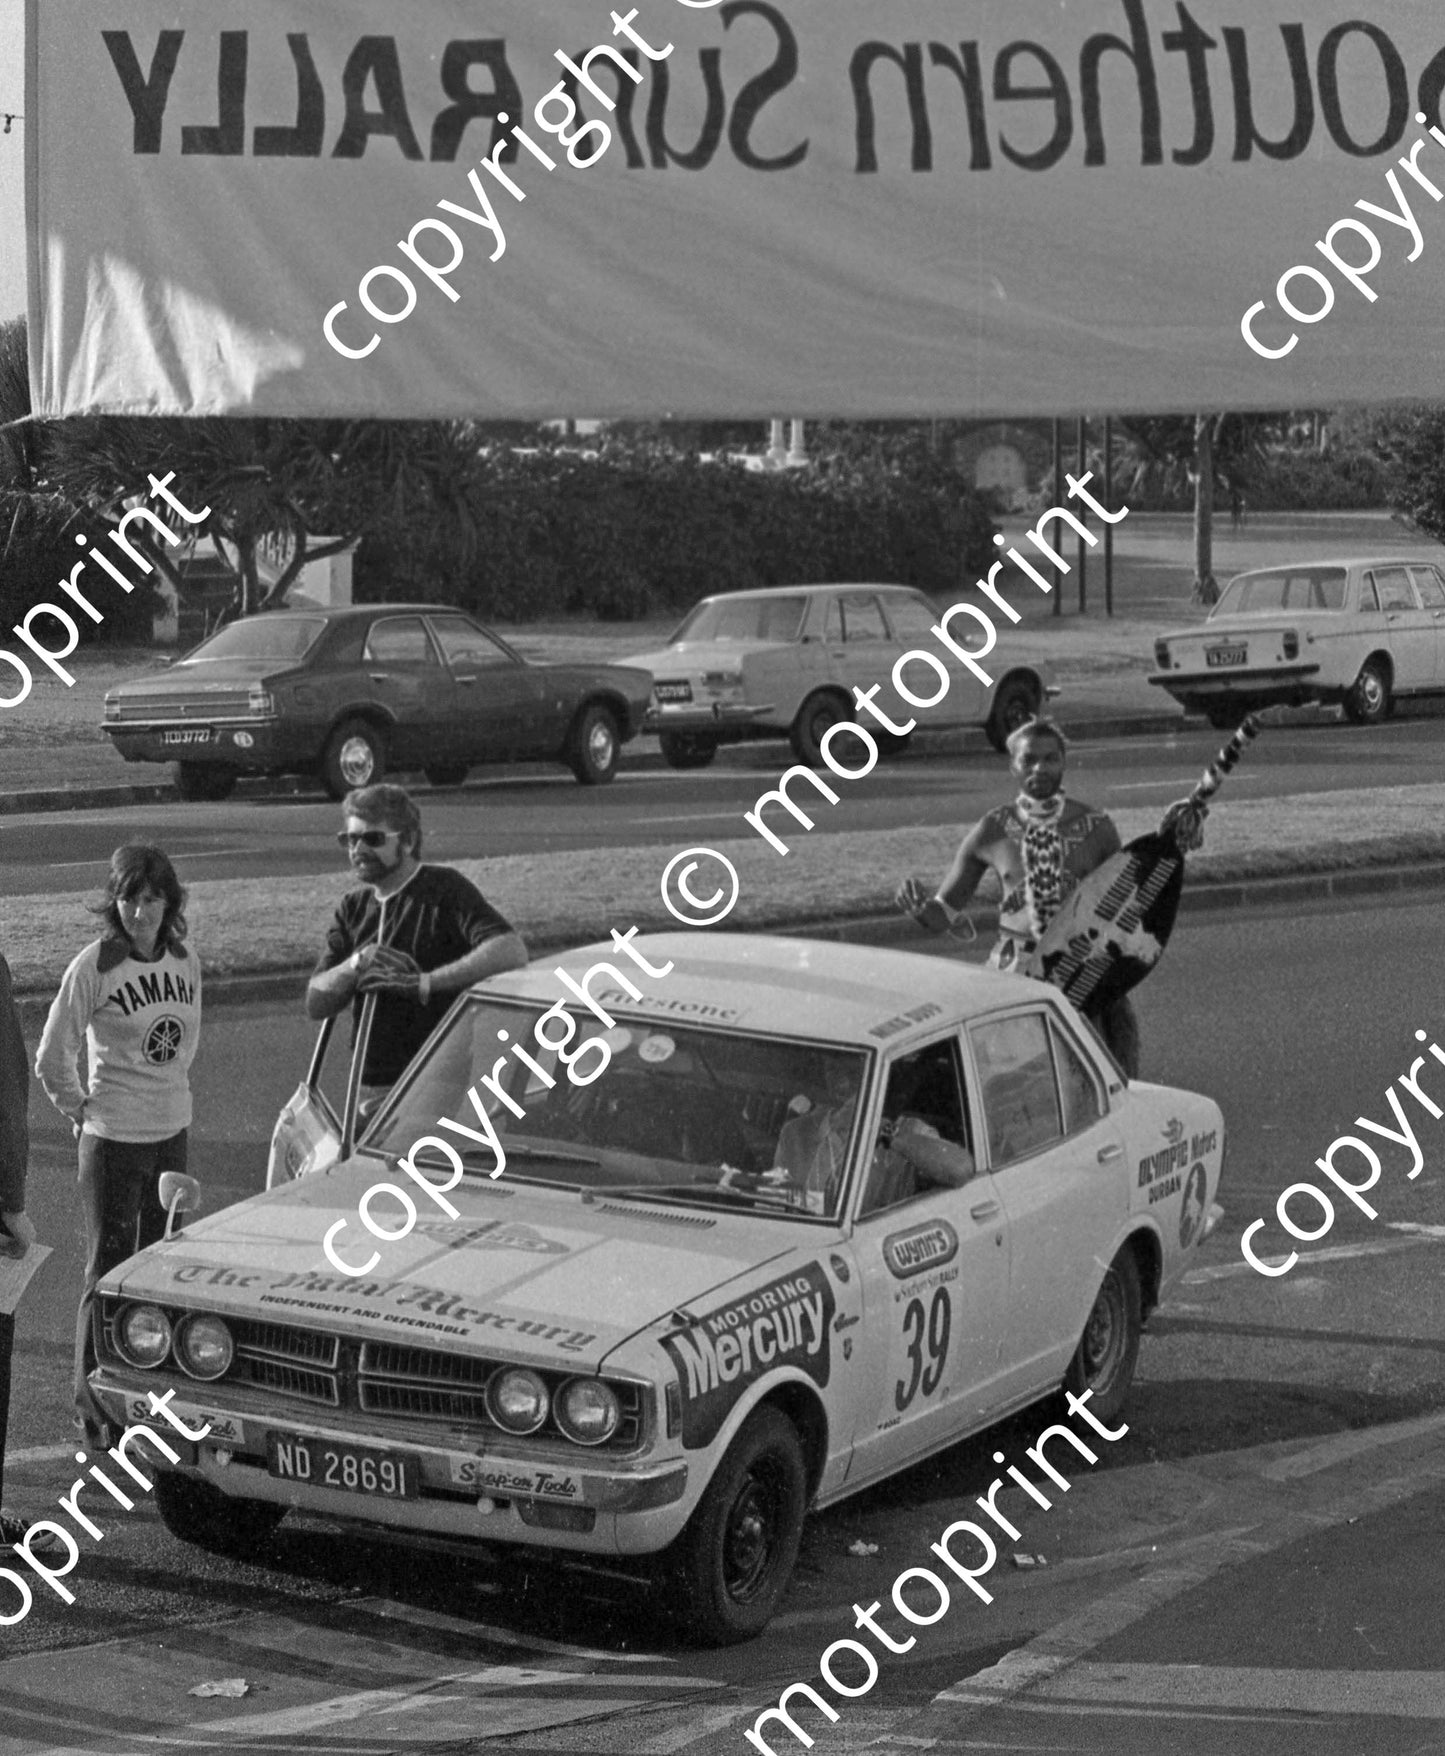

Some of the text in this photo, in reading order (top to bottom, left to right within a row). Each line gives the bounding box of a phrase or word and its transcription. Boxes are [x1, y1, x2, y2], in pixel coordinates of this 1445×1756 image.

[1138, 1139, 1188, 1188] OLYMPIC
[1149, 1173, 1181, 1205] DURBAN
[173, 1265, 261, 1288] The
[396, 1285, 597, 1351] Mercury
[259, 1294, 471, 1336] INDEPENDENT AND DEPENDABLE
[708, 1277, 812, 1335] MOTORING
[671, 1291, 824, 1400] Mercury
[895, 1286, 951, 1412] 39
[277, 1443, 406, 1496] ND 28691
[535, 1472, 577, 1493] Tools
